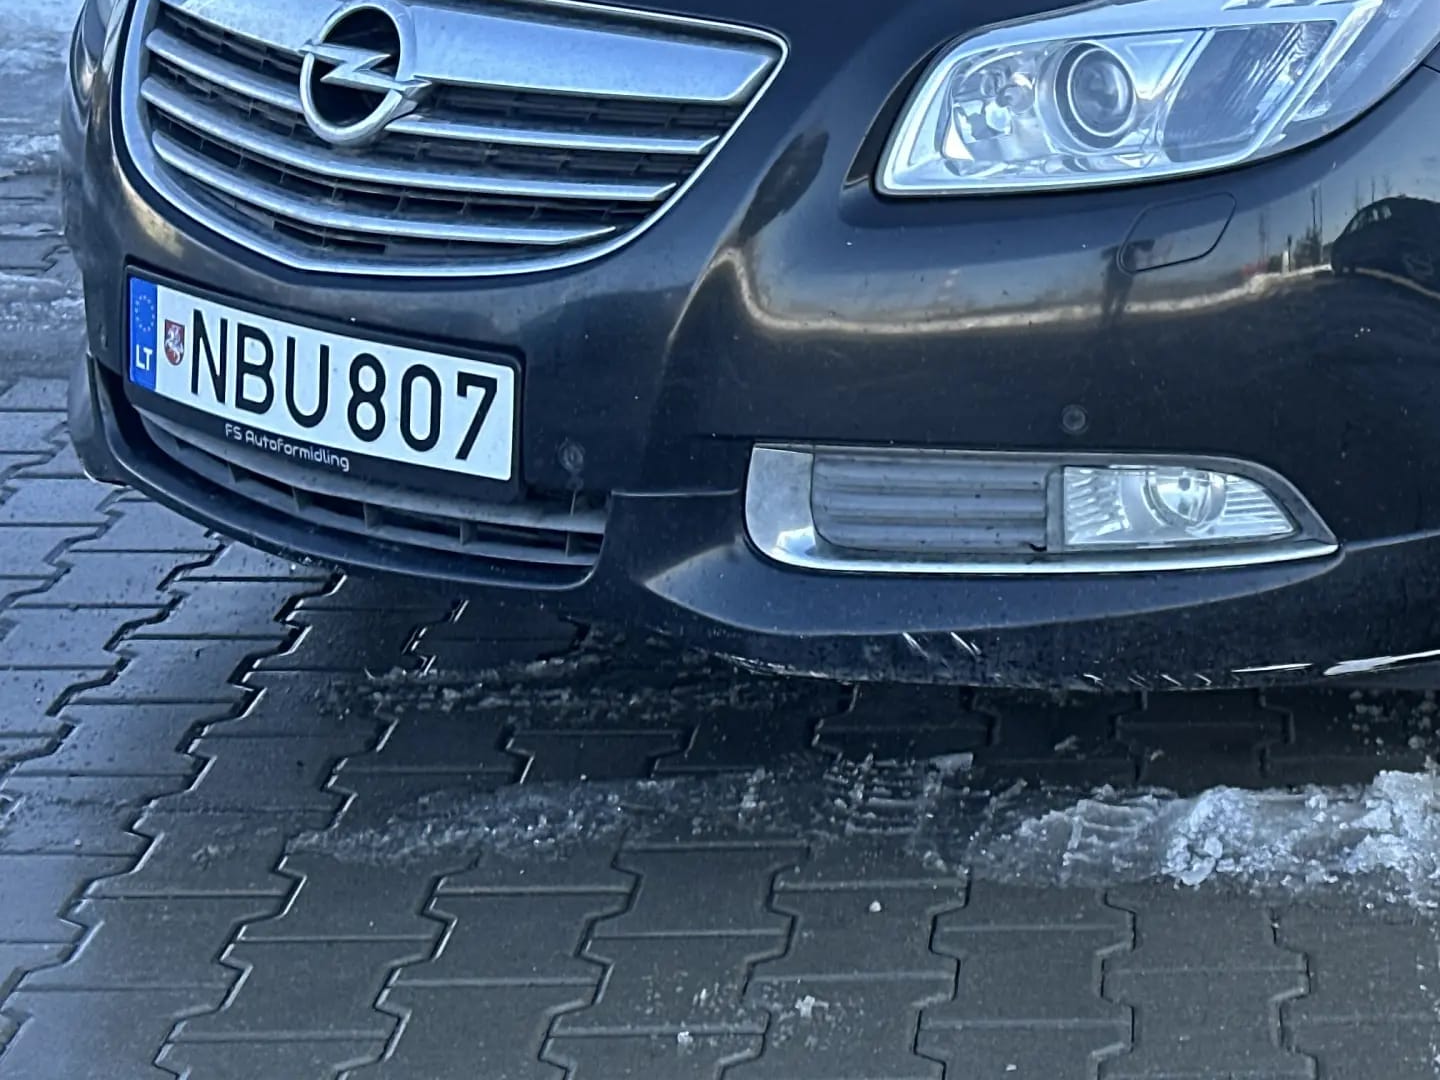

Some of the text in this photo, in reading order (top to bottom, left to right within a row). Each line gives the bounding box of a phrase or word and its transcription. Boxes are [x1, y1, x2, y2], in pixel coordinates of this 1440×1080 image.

[135, 344, 153, 371] LT
[225, 423, 350, 472] FS Autoformidling
